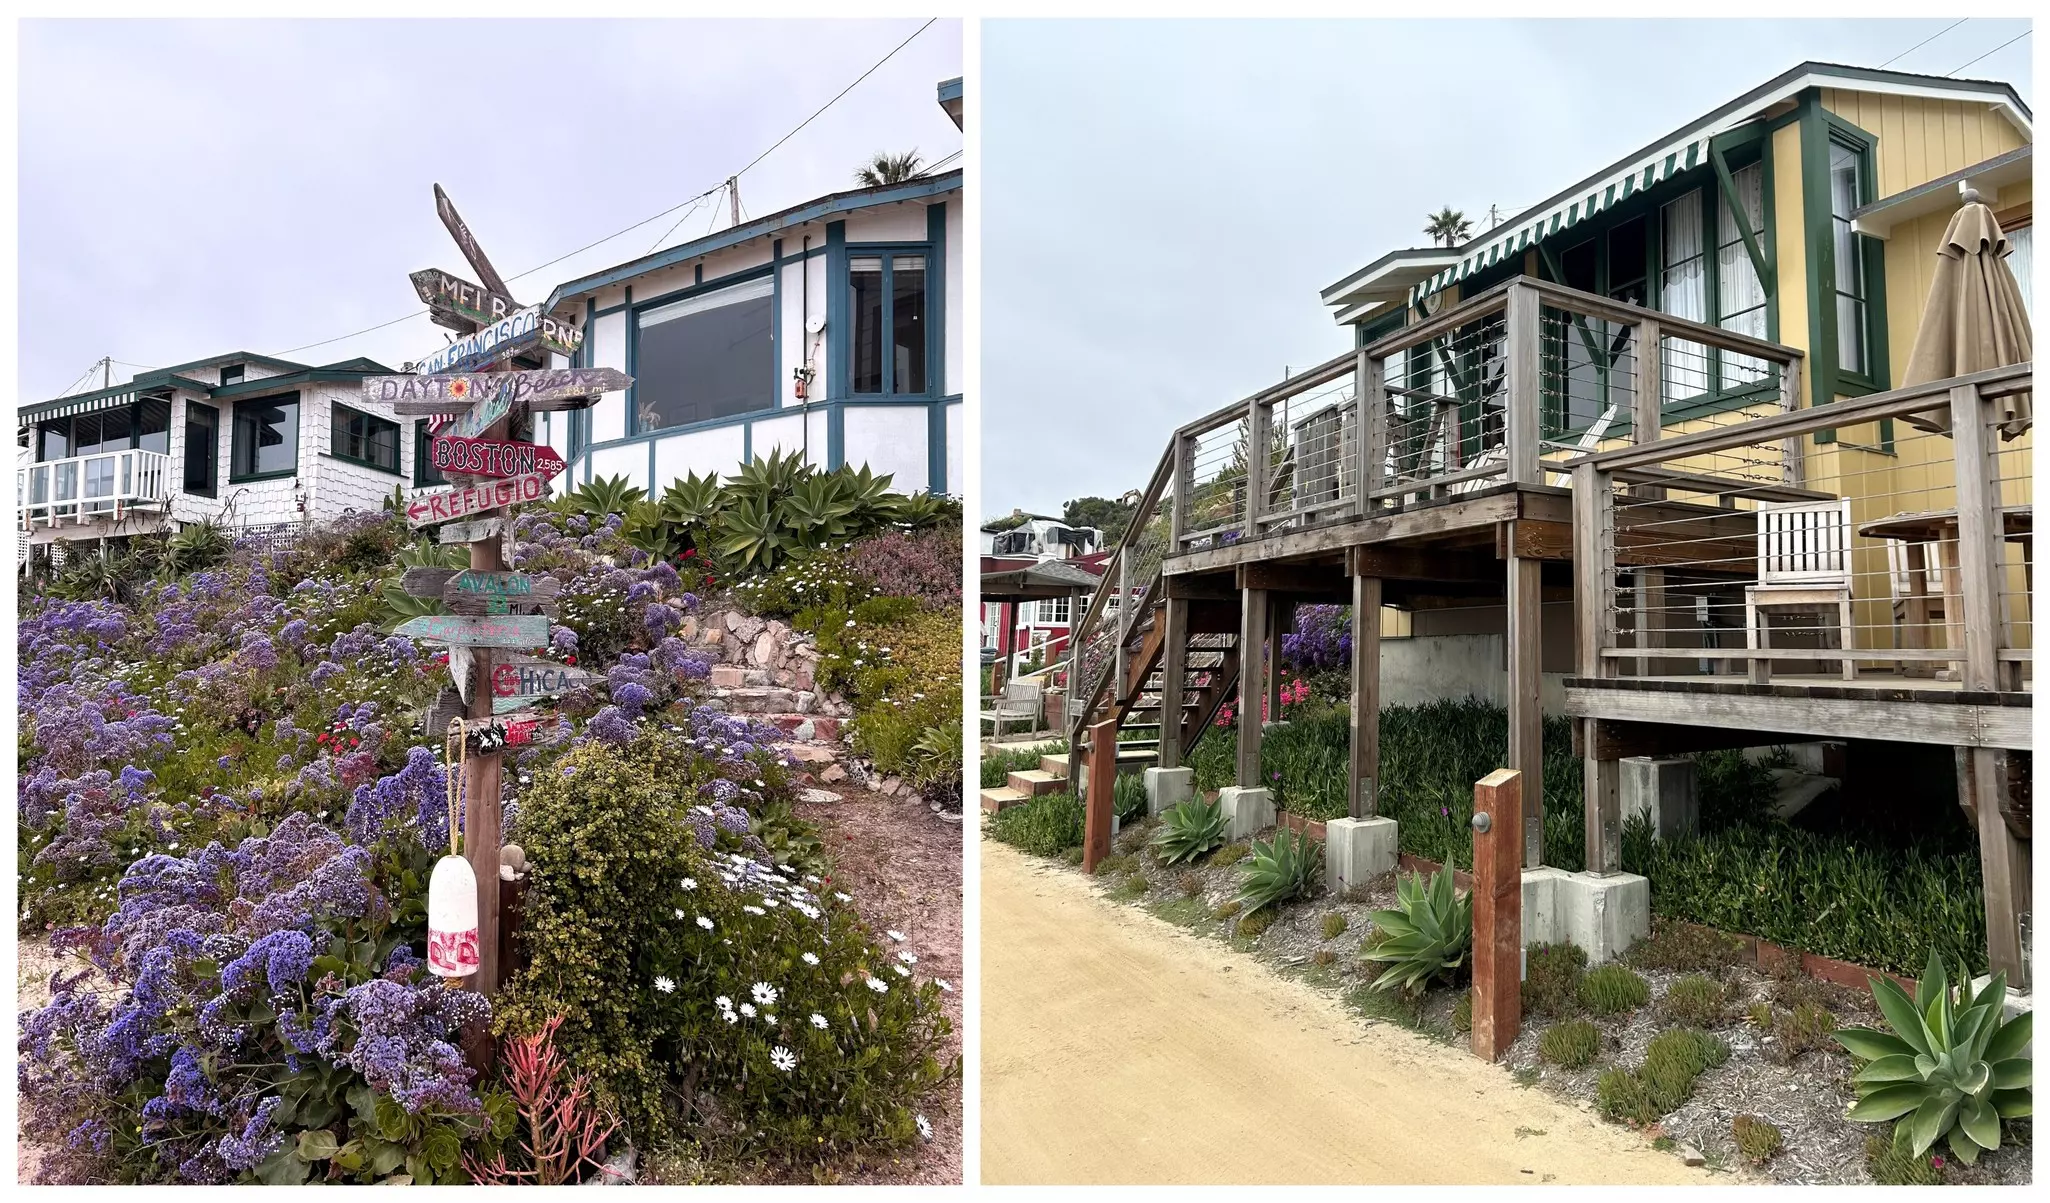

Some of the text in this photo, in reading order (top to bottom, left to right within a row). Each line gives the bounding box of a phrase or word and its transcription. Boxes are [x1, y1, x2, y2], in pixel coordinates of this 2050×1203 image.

[440, 274, 583, 349] MELBRNE
[436, 439, 536, 476] BOSTON
[429, 476, 540, 520] REFUGIO
[458, 572, 531, 595] AVALON
[493, 663, 592, 696] CHICAGO
